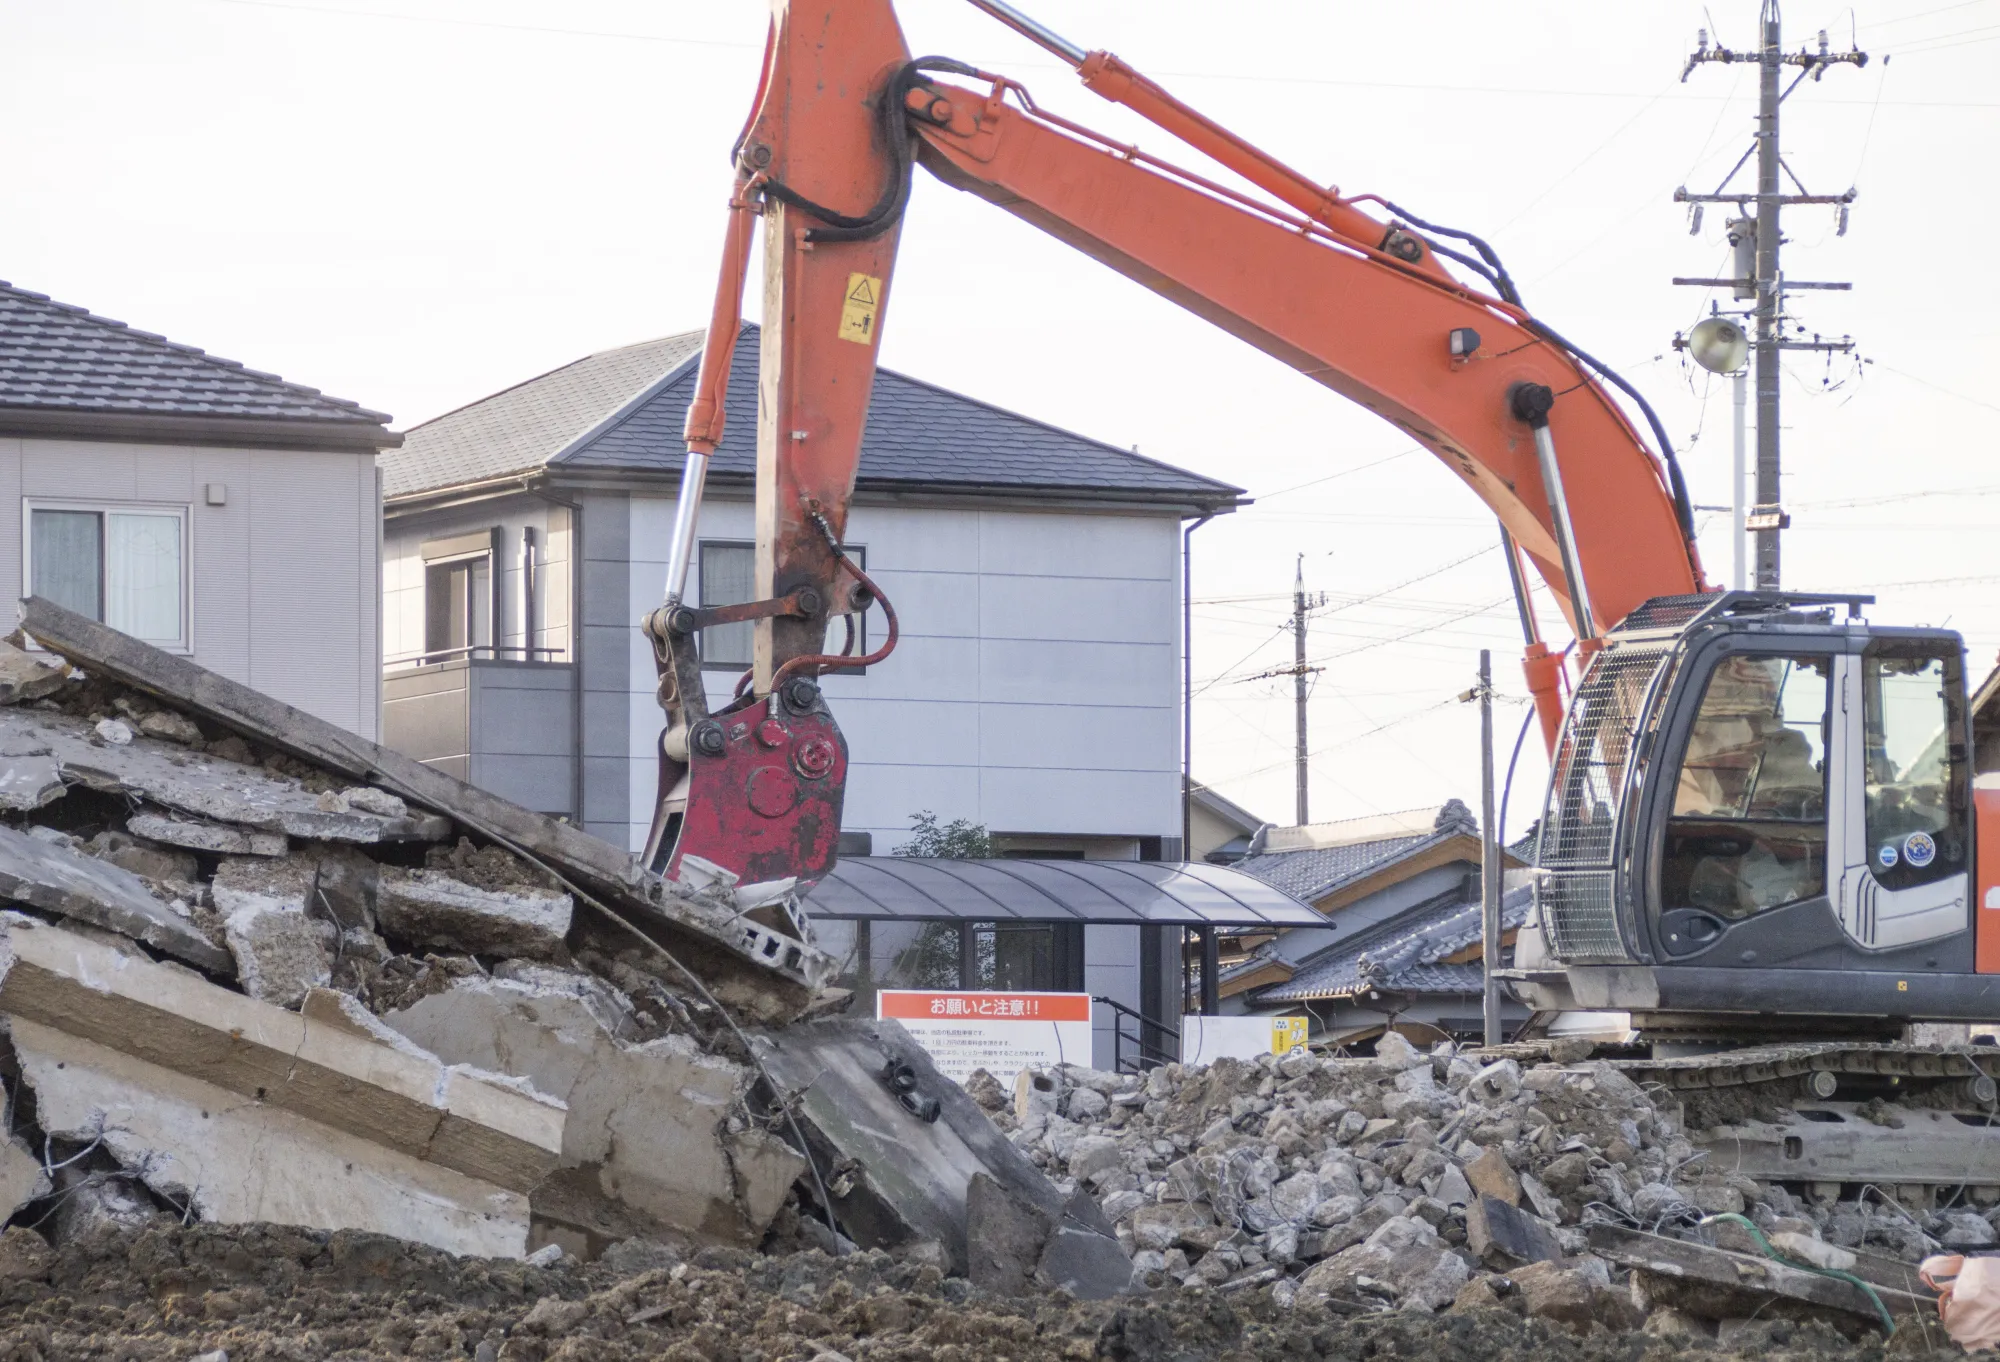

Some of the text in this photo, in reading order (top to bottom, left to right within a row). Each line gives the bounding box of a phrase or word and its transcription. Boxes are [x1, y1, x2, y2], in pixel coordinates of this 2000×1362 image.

[930, 998, 1039, 1016] お願いと注意!!
